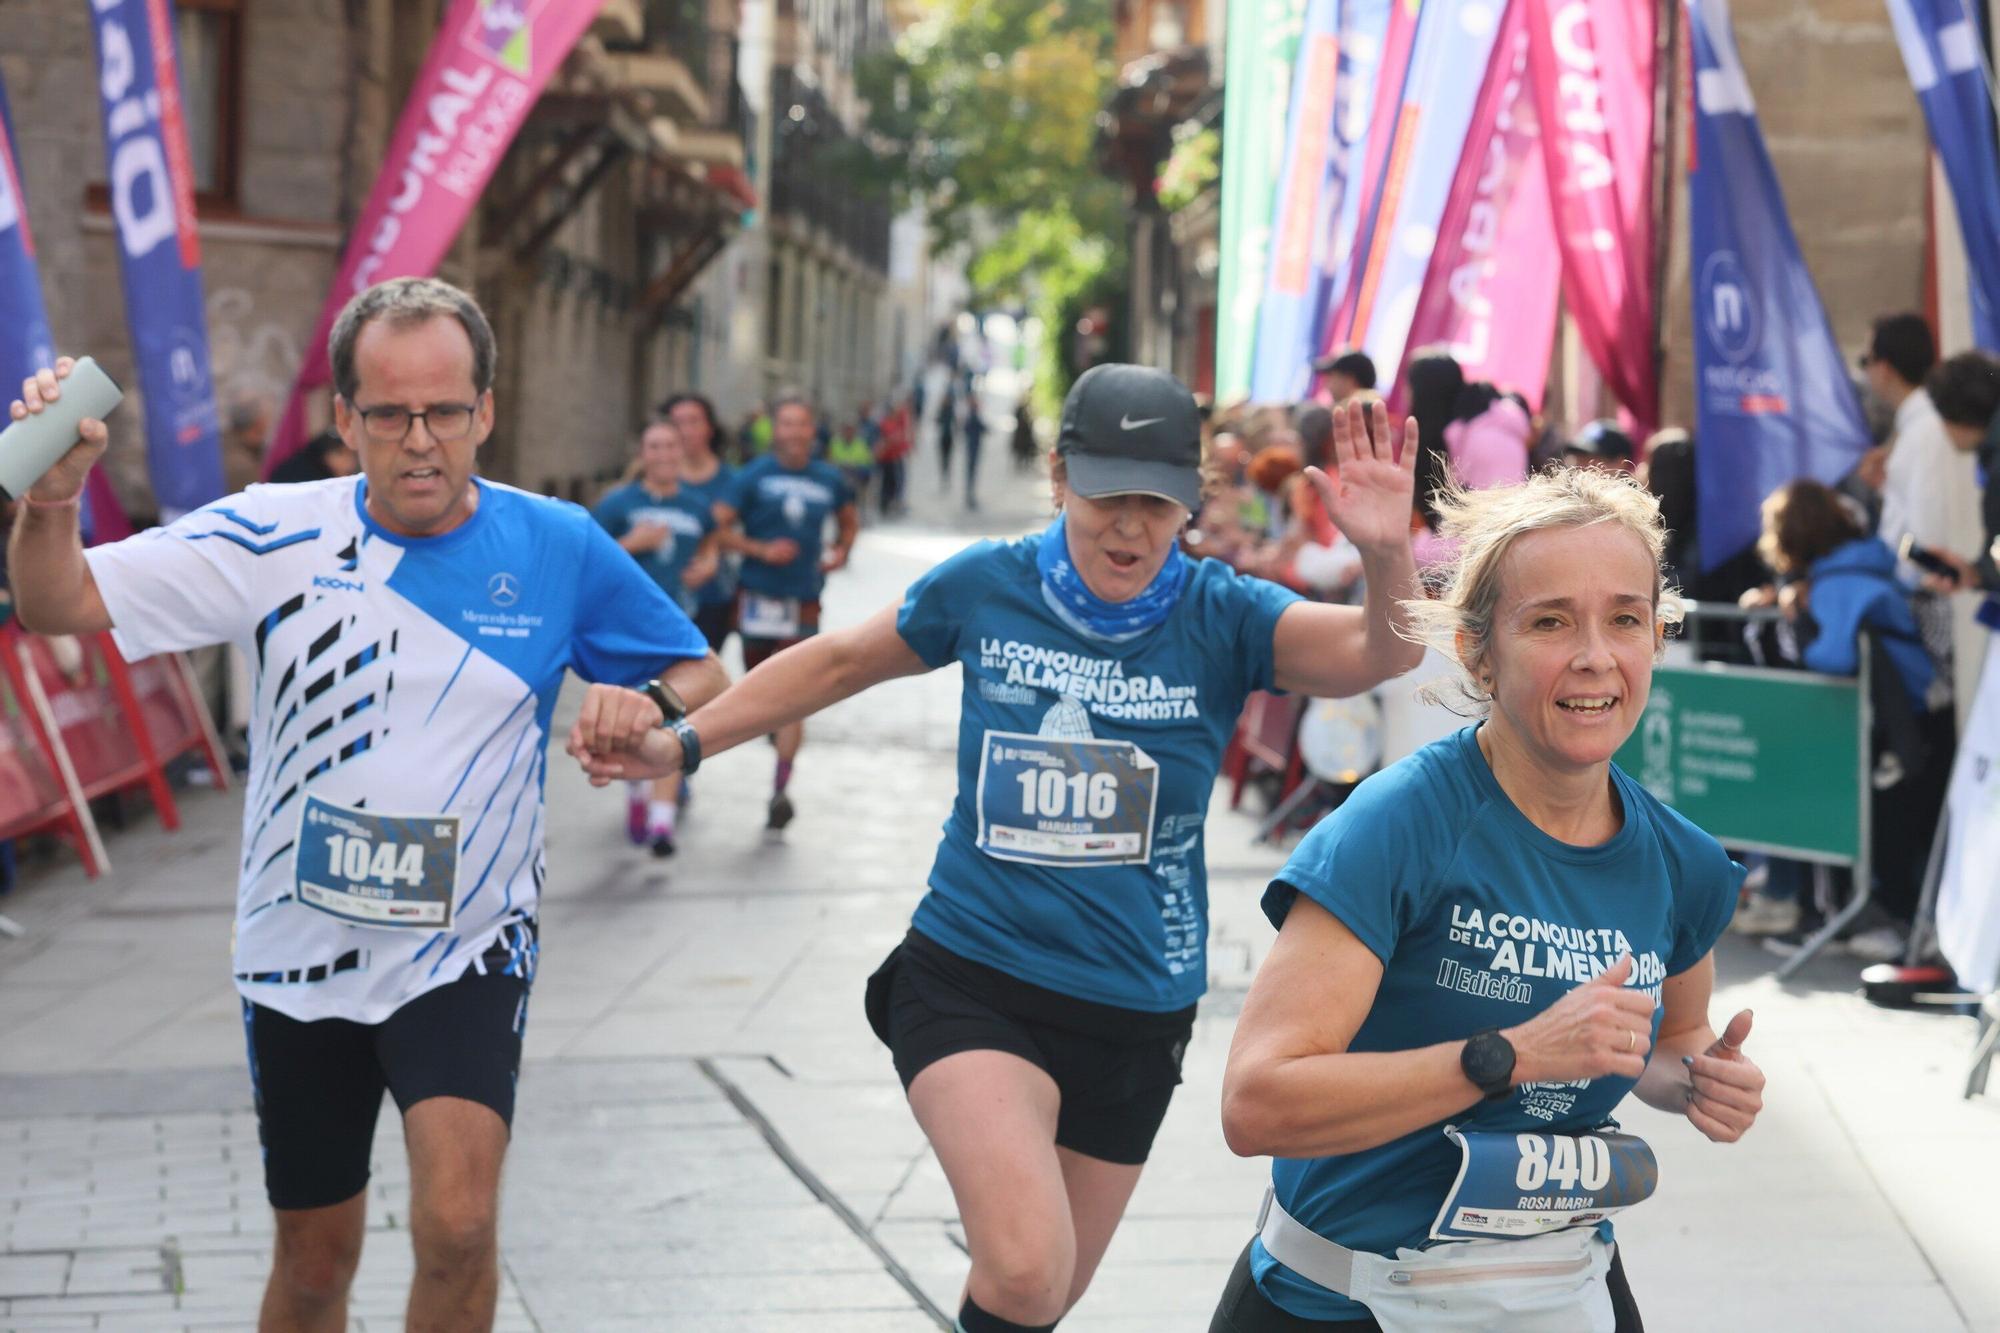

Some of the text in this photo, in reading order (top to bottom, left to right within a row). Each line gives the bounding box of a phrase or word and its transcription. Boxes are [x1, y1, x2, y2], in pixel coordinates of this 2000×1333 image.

[981, 637, 1124, 678] LA CONQUISTA
[1091, 699, 1199, 719] KONKISTA
[1016, 768, 1119, 819] 1016
[325, 834, 425, 887] 1044
[1451, 904, 1634, 953] LA CONQUISTA
[1449, 927, 1471, 945] DE
[1475, 932, 1496, 951] LA
[1489, 939, 1663, 986] ALMENDRA
[1436, 957, 1459, 989] II
[1457, 967, 1532, 1005] Edición
[1523, 1105, 1555, 1121] 2025
[1515, 1133, 1611, 1191] 840
[1517, 1196, 1594, 1210] ROSA MARIA
